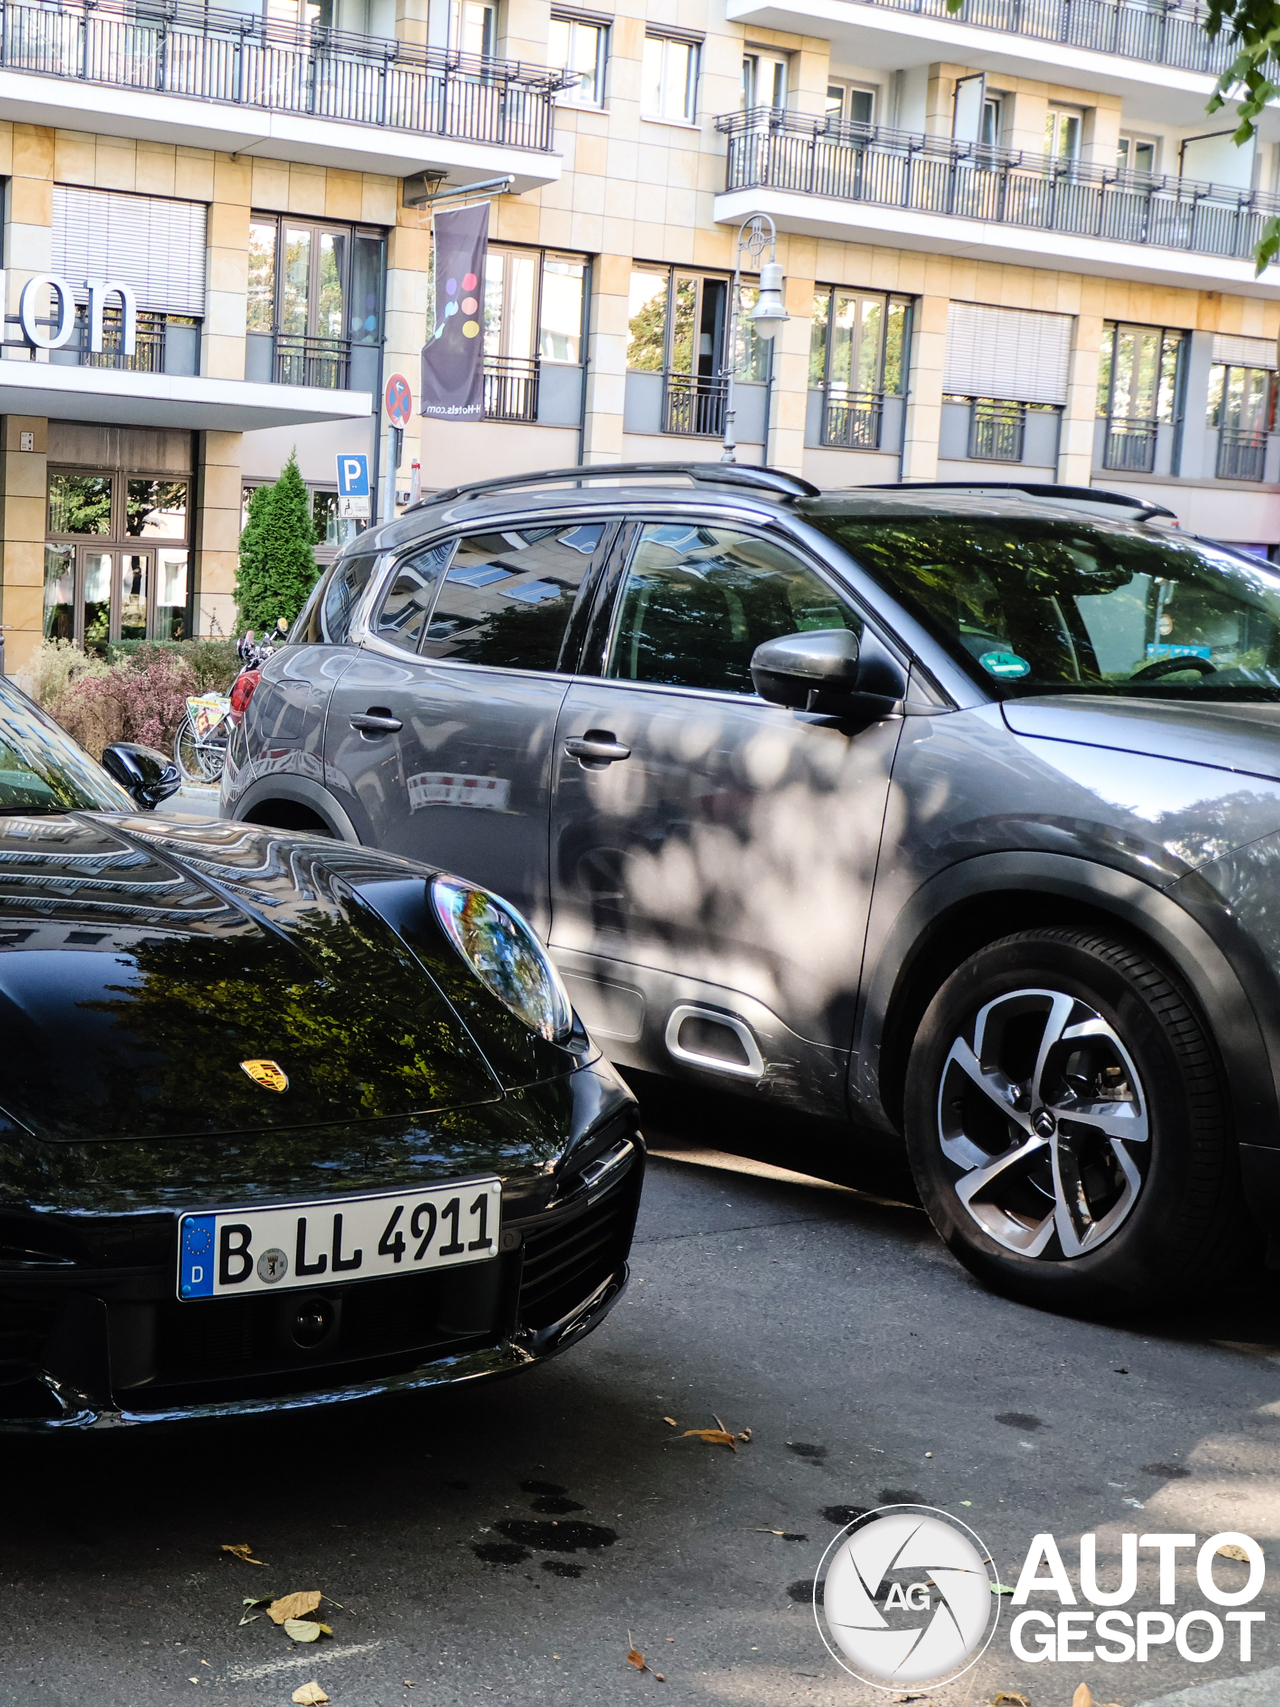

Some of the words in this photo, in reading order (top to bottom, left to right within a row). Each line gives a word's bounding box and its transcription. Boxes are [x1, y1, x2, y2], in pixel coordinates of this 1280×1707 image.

[343, 459, 362, 492] P
[191, 1265, 204, 1283] D
[219, 1223, 254, 1285] B
[295, 1213, 363, 1276] LL
[377, 1193, 493, 1263] 4911
